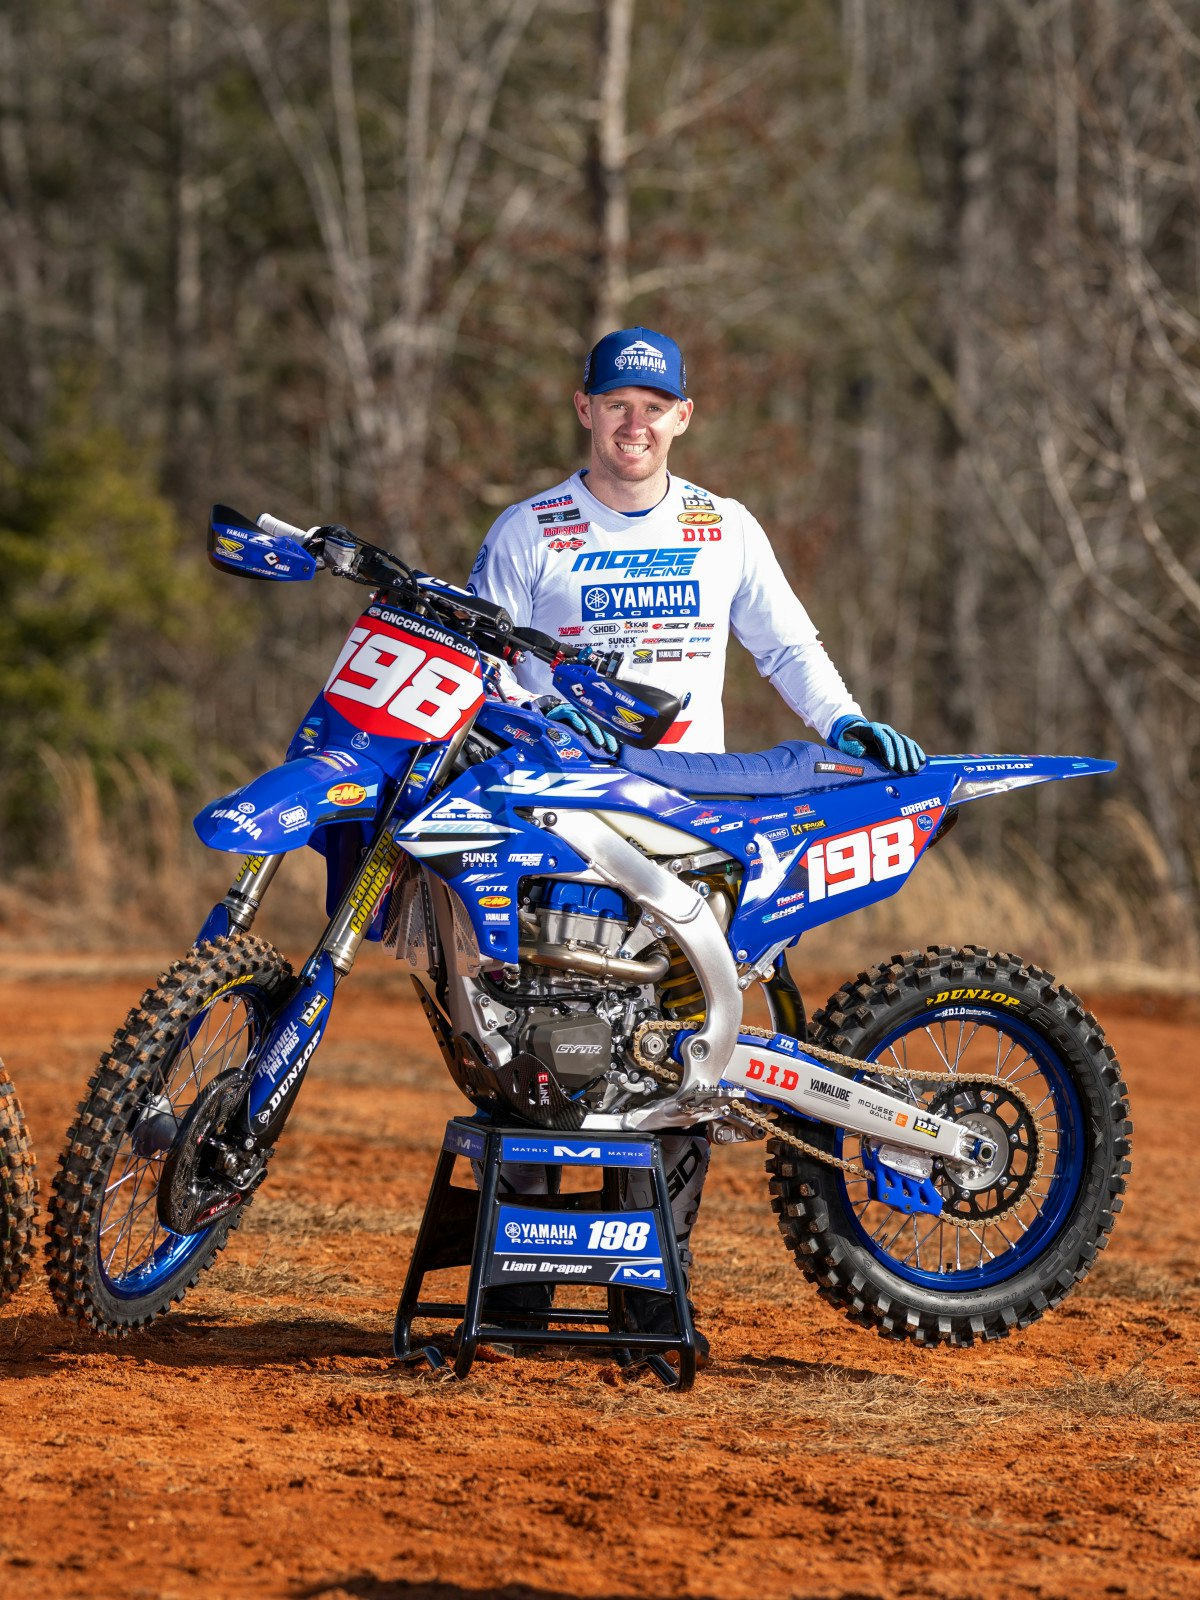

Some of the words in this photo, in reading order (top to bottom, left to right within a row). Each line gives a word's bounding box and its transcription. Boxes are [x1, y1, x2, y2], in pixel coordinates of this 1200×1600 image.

[618, 366, 665, 374] RACING
[627, 355, 667, 371] YAMAHA
[531, 494, 573, 508] PARTS
[532, 500, 574, 511] UNLIMITED
[679, 513, 721, 525] FMF
[226, 528, 248, 540] YAMAHA
[548, 538, 586, 550] IMS
[570, 547, 703, 573] MOOSE
[624, 566, 693, 579] RACING
[610, 584, 697, 609] YAMAHA
[595, 609, 691, 619] RACING
[593, 625, 616, 634] SHOEI
[663, 622, 690, 630] SIDI
[380, 610, 477, 658] GNCCRACING.COM
[608, 637, 636, 645] SUNEX
[614, 691, 636, 708] YAMAHA
[976, 762, 1034, 772] DUNLOP
[327, 783, 366, 801] FMF
[794, 803, 811, 814] TM
[900, 796, 942, 817] DRAPER
[210, 808, 263, 841] YAMAHA
[720, 821, 744, 833] SIDI
[462, 852, 498, 863] SUNEX
[507, 853, 544, 863] MOOSE
[807, 818, 916, 903] 198
[349, 830, 394, 911] Factory
[348, 843, 401, 935] Connecti
[479, 897, 511, 907] FMF
[485, 913, 510, 922] YAMALUBE
[934, 989, 1022, 1007] DUNLOP
[257, 1020, 300, 1079] TRAMMELL
[555, 1044, 603, 1055] GYTR
[780, 1037, 795, 1049] TM
[265, 1057, 283, 1084] TIRE
[280, 1032, 301, 1066] PROS
[268, 1030, 322, 1112] DUNLOP
[745, 1058, 800, 1091] D.I.D
[809, 1078, 851, 1102] YAMALUBE
[857, 1098, 897, 1117] MOUSSE
[869, 1108, 893, 1122] BALLS
[916, 1118, 940, 1132] DP
[521, 1223, 578, 1239] YAMAHA
[587, 1221, 651, 1251] 198
[501, 1260, 538, 1272] Liam
[539, 1262, 593, 1275] Draper
